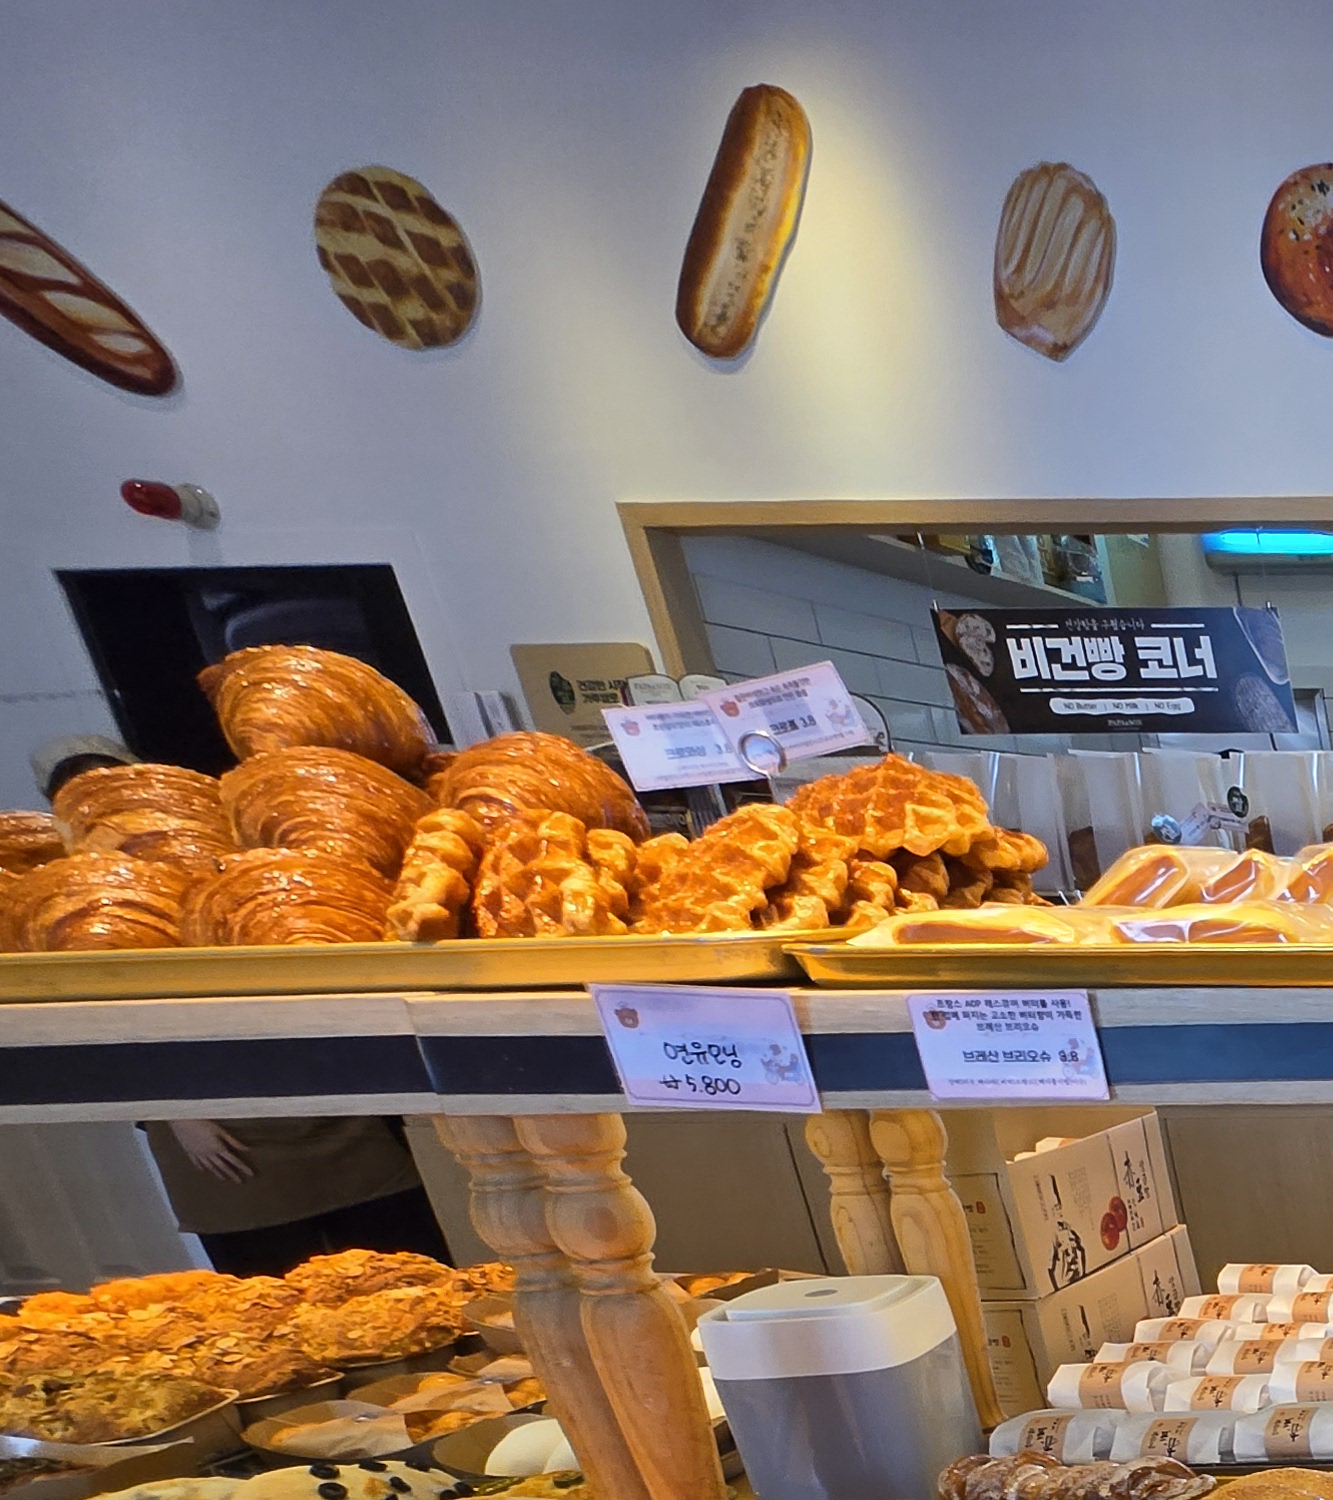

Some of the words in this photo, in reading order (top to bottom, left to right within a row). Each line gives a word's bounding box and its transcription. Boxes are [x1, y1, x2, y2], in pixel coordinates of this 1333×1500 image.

[1006, 636, 1127, 681] 비건빵
[1134, 636, 1218, 679] 코너
[962, 1050, 1000, 1063] 브레산
[1003, 1050, 1052, 1063] 브리오슈
